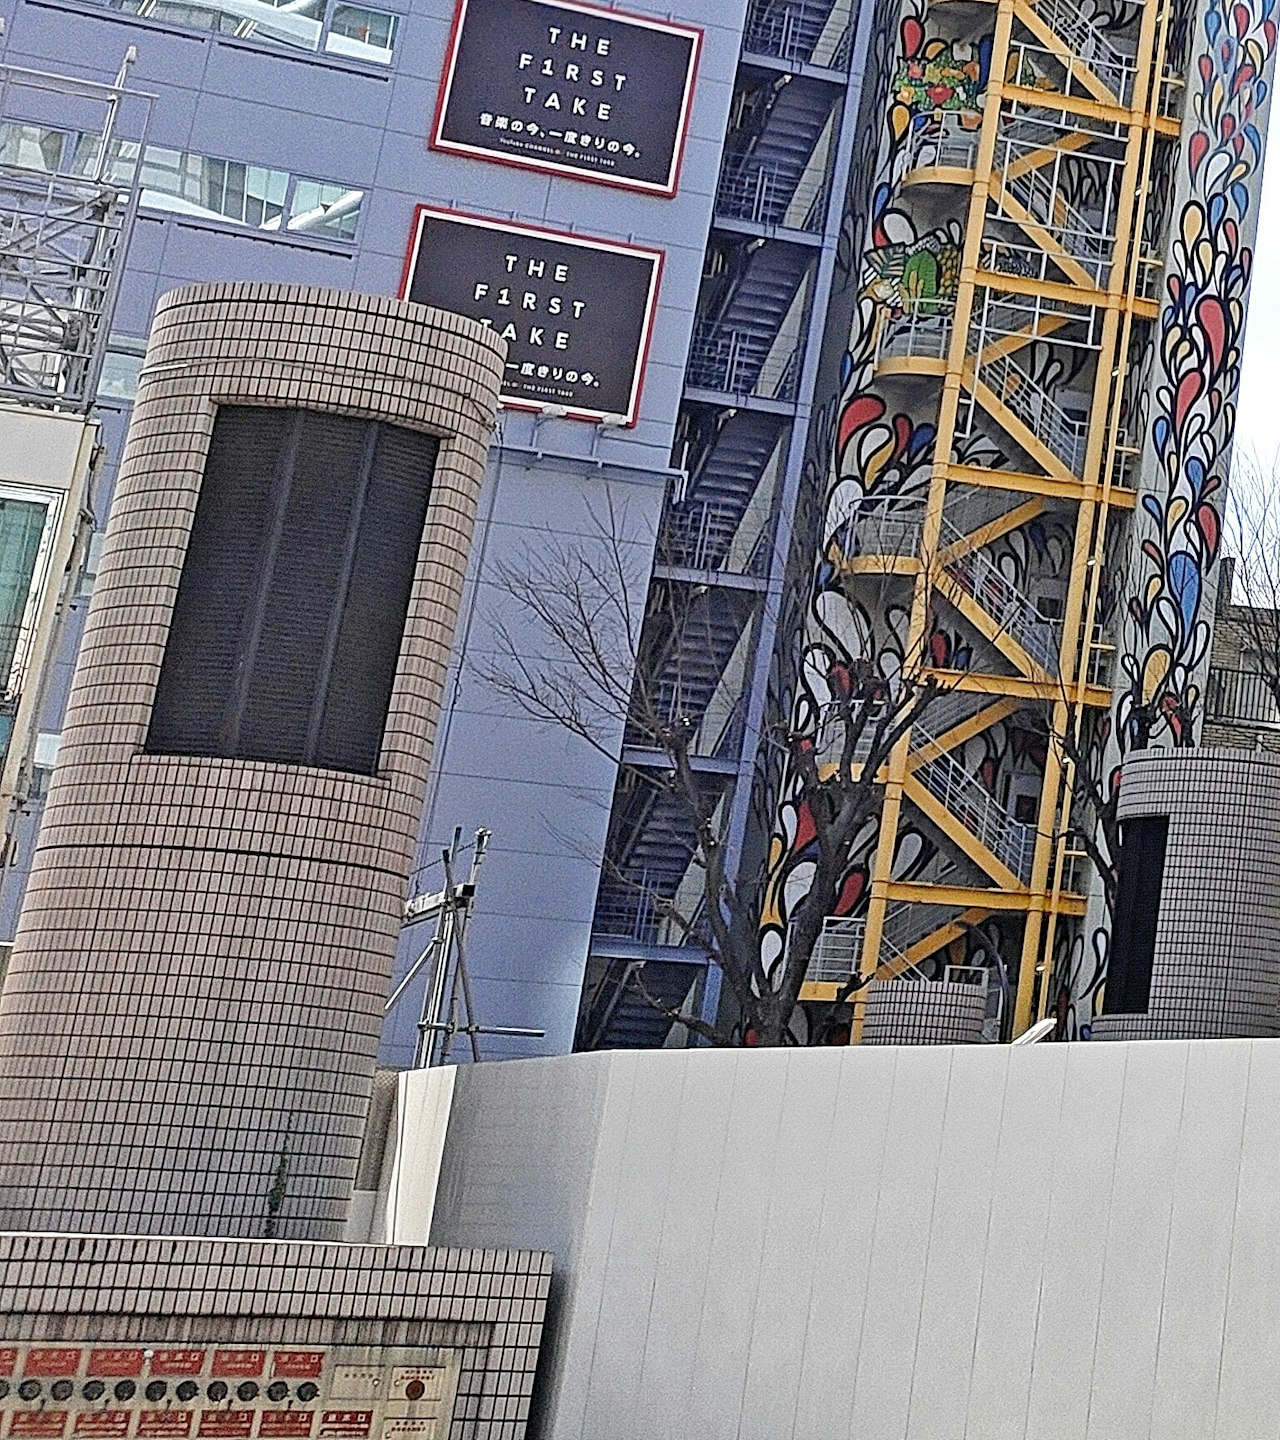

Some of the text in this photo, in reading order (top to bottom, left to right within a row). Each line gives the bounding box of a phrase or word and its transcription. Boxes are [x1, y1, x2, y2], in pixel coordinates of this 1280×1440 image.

[549, 27, 611, 56] THE
[518, 53, 627, 91] F1RST
[524, 87, 612, 121] TAKE
[505, 254, 569, 282] THE
[474, 283, 586, 319] F1RST
[505, 362, 600, 388] 一度きりの今。
